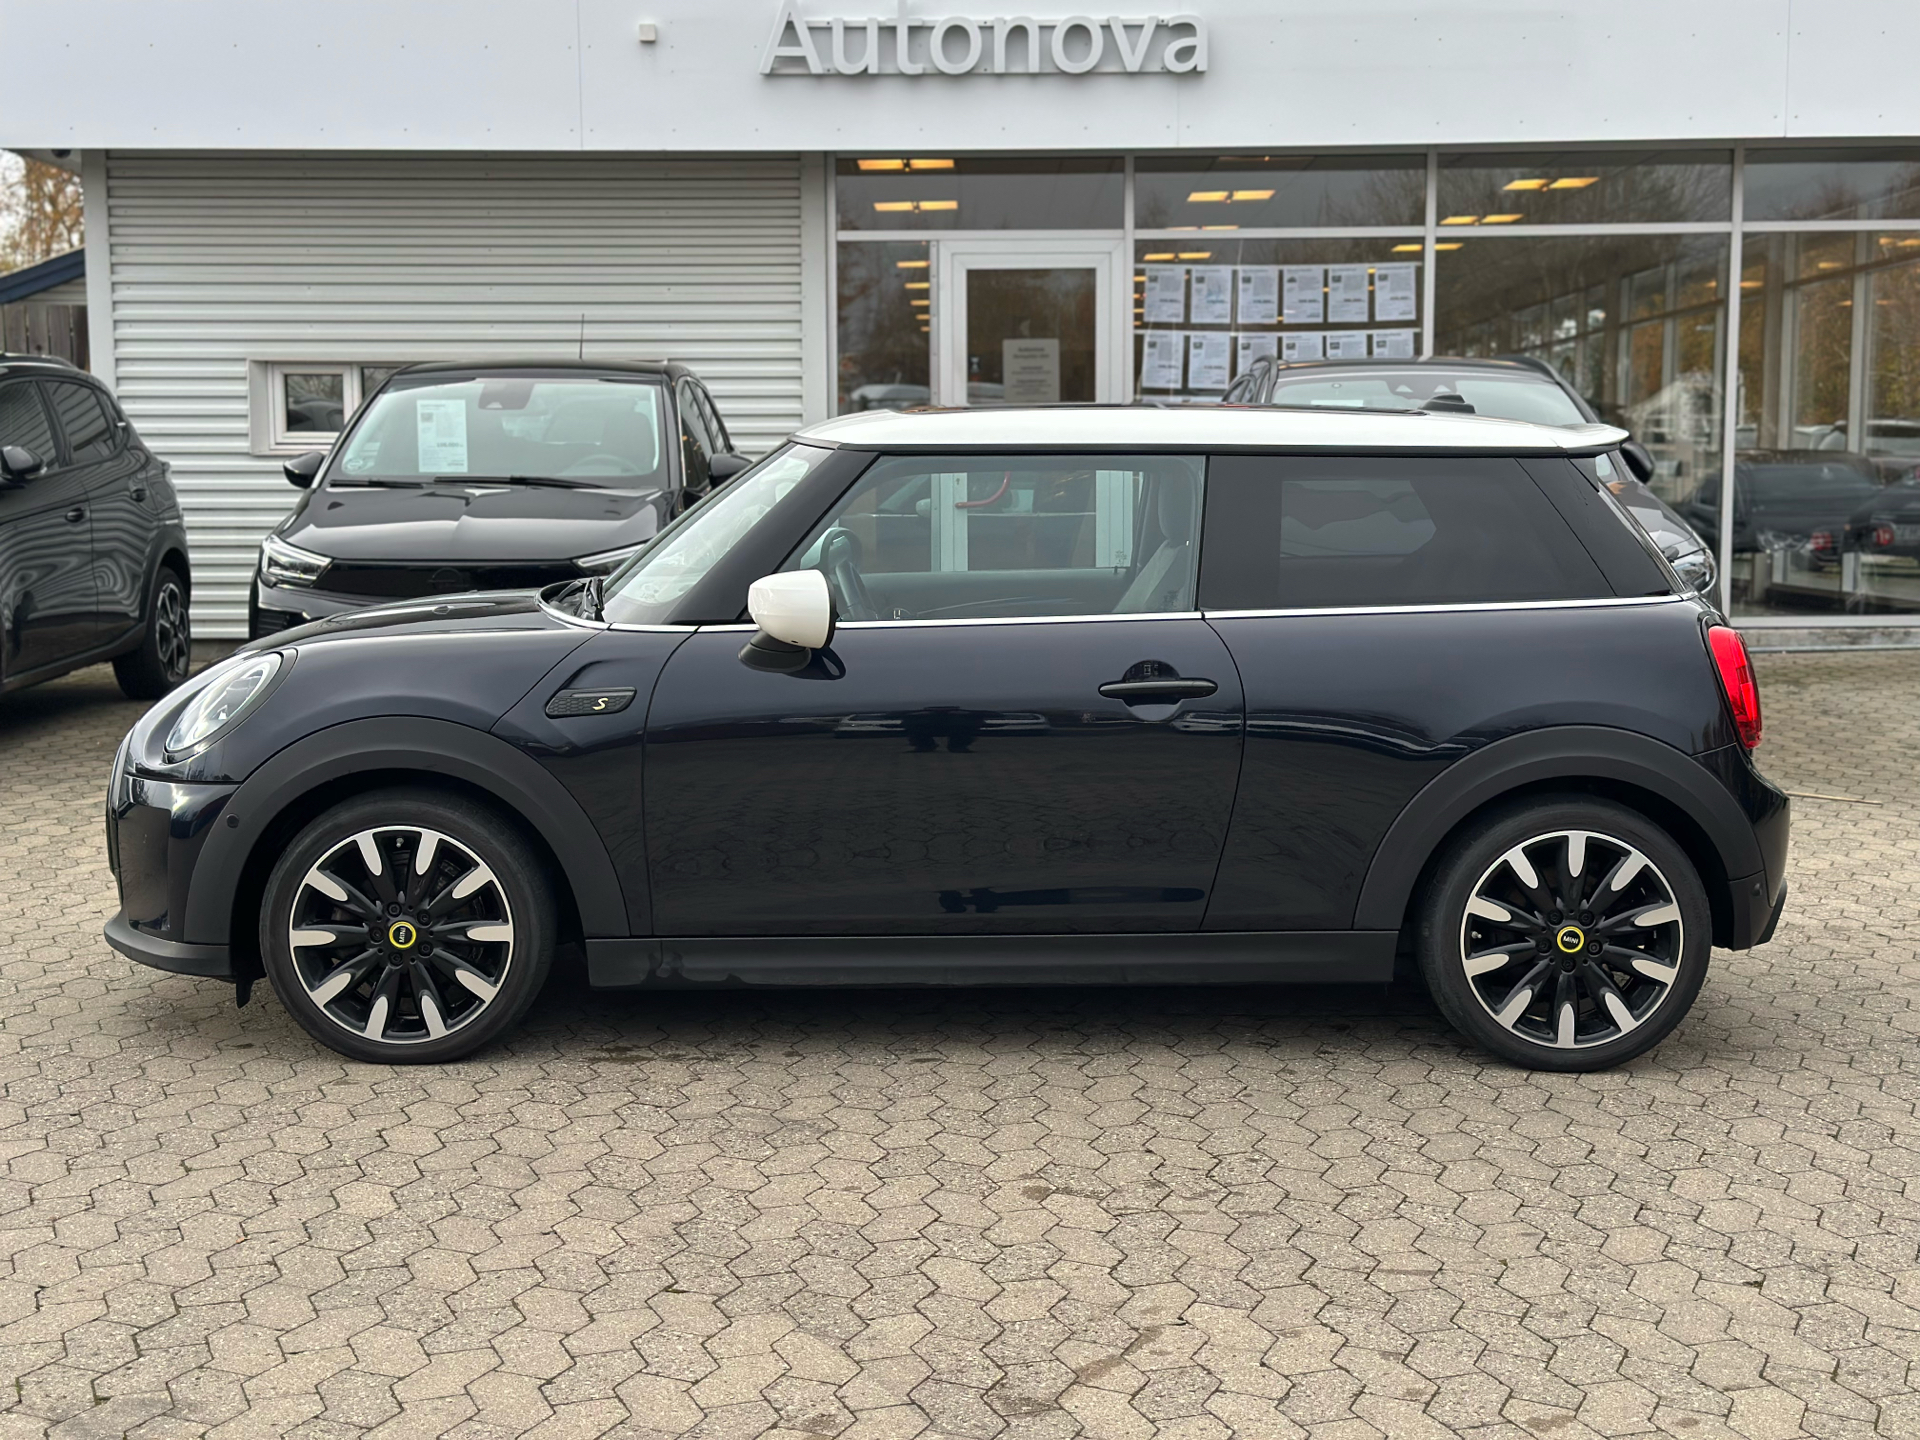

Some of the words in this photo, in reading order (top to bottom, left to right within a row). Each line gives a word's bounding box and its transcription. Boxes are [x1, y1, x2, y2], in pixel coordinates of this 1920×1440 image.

[759, 0, 1208, 75] Autonova
[592, 697, 609, 711] S
[398, 927, 407, 943] MINI
[1562, 935, 1579, 944] MINI
